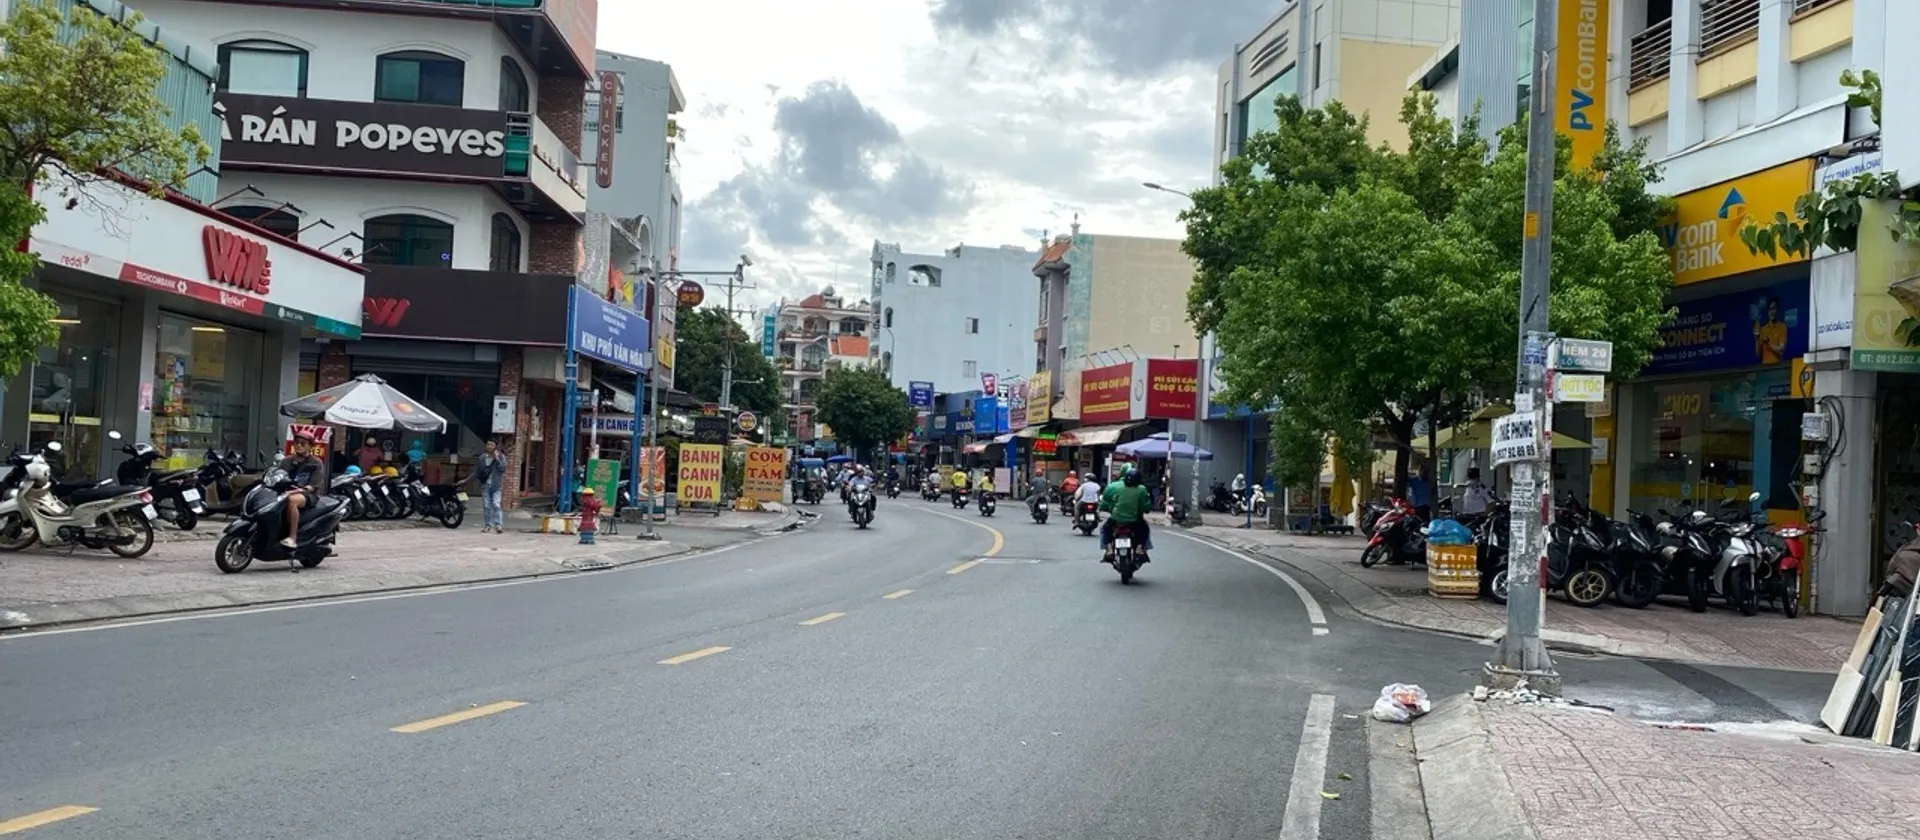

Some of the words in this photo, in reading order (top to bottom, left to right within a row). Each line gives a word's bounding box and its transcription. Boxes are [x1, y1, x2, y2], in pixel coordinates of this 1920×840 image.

[241, 105, 316, 147] RÁN
[599, 80, 613, 177] CHICKEN
[1676, 242, 1724, 273] Bank
[136, 270, 176, 289] TECHCOMBANK
[581, 330, 597, 352] KHU
[597, 336, 613, 357] PHỐ
[614, 342, 629, 363] VĂN
[1592, 349, 1607, 358] 20
[606, 418, 628, 431] CANH
[682, 447, 720, 464] BÁNH
[750, 450, 783, 463] CƠM
[681, 467, 720, 482] CANH
[748, 464, 782, 480] TẤM
[684, 485, 713, 499] CUA
